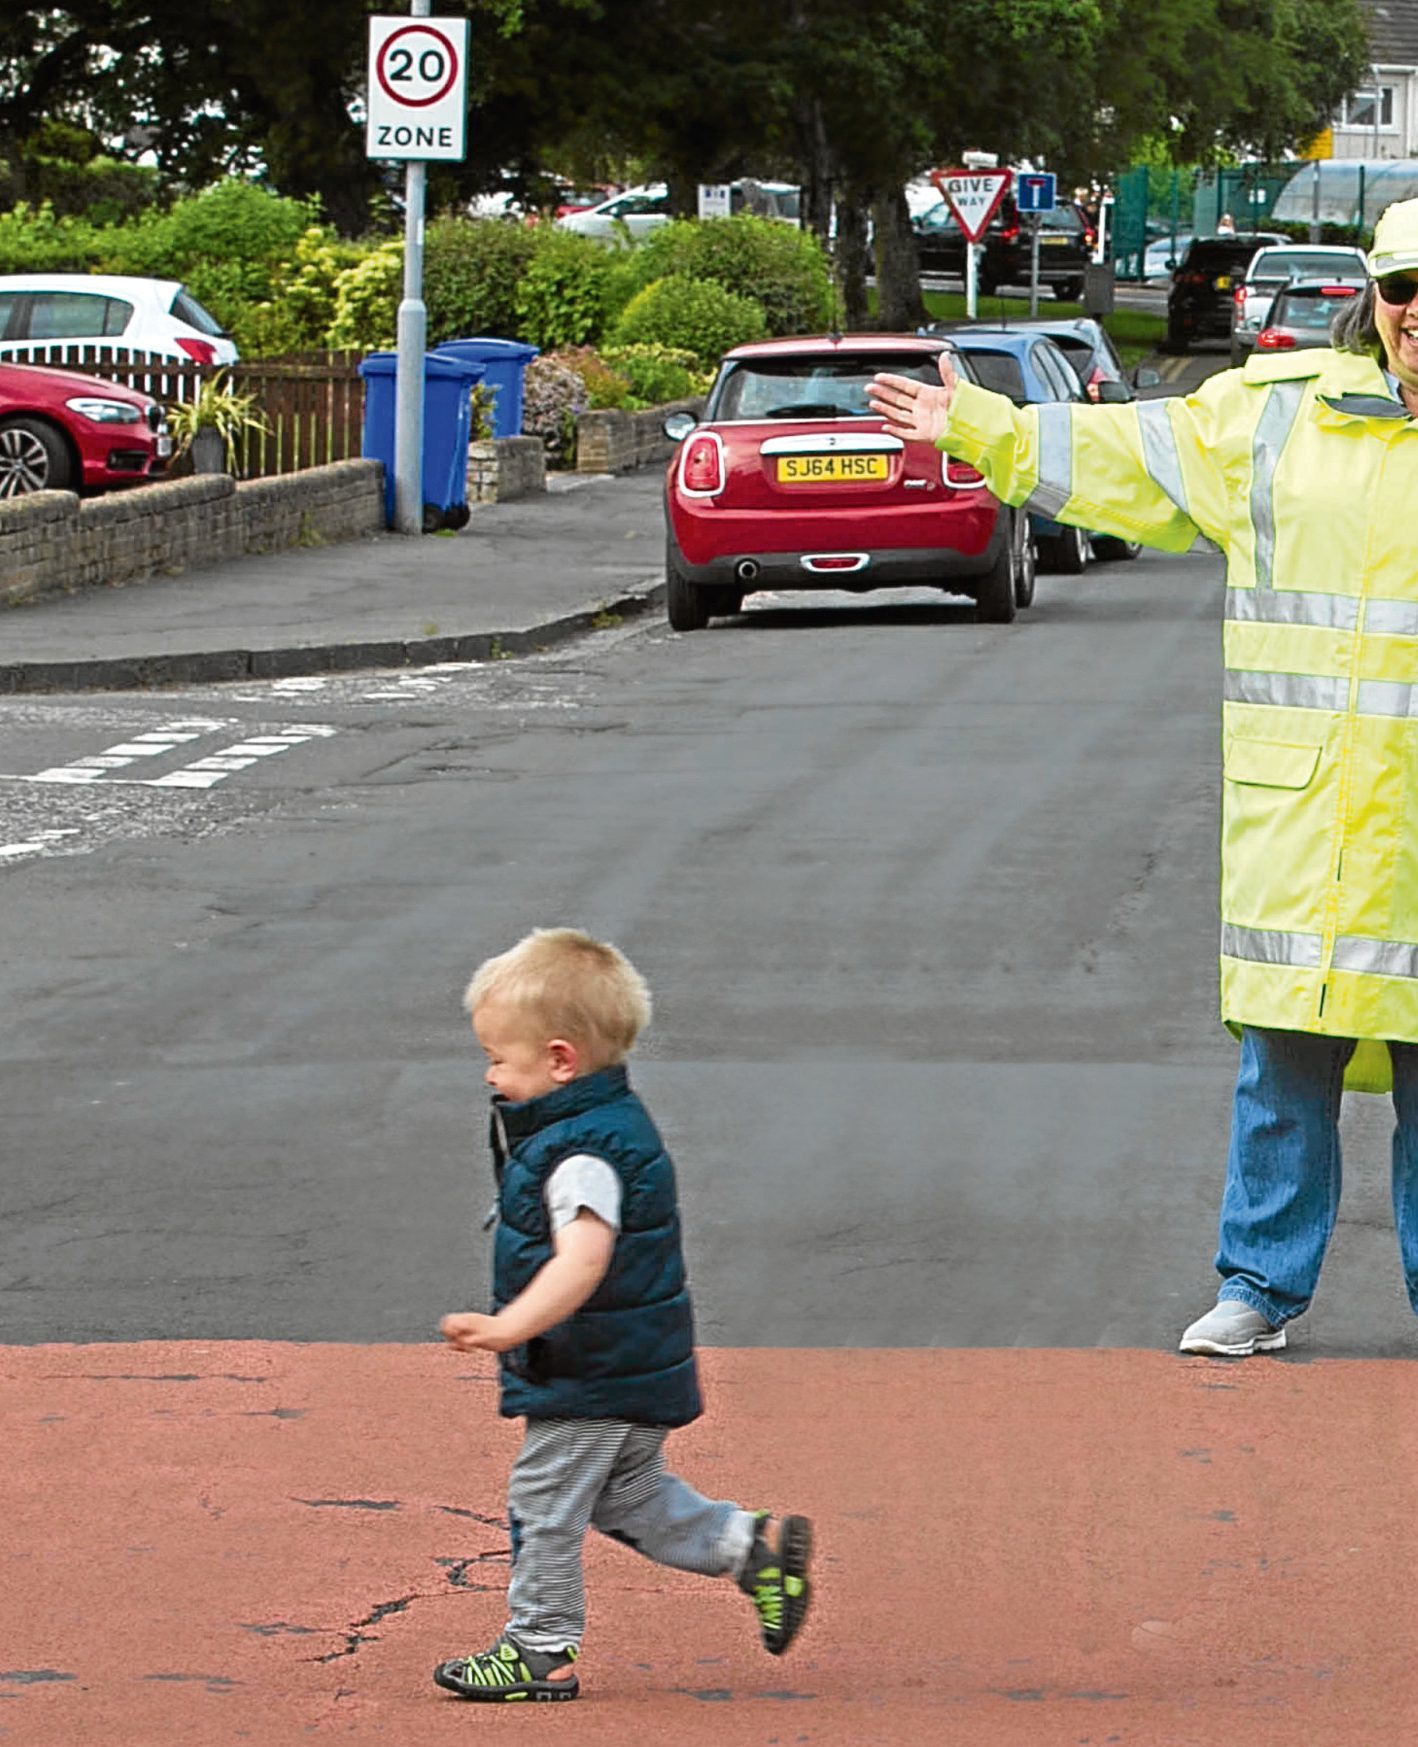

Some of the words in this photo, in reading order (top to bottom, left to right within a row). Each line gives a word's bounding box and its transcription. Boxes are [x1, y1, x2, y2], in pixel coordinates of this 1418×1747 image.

[390, 49, 444, 82] 20
[378, 126, 452, 147] ZONE
[948, 178, 993, 192] GIVE
[957, 196, 986, 206] WAY
[786, 459, 834, 477] SJ64
[841, 457, 878, 475] HSC
